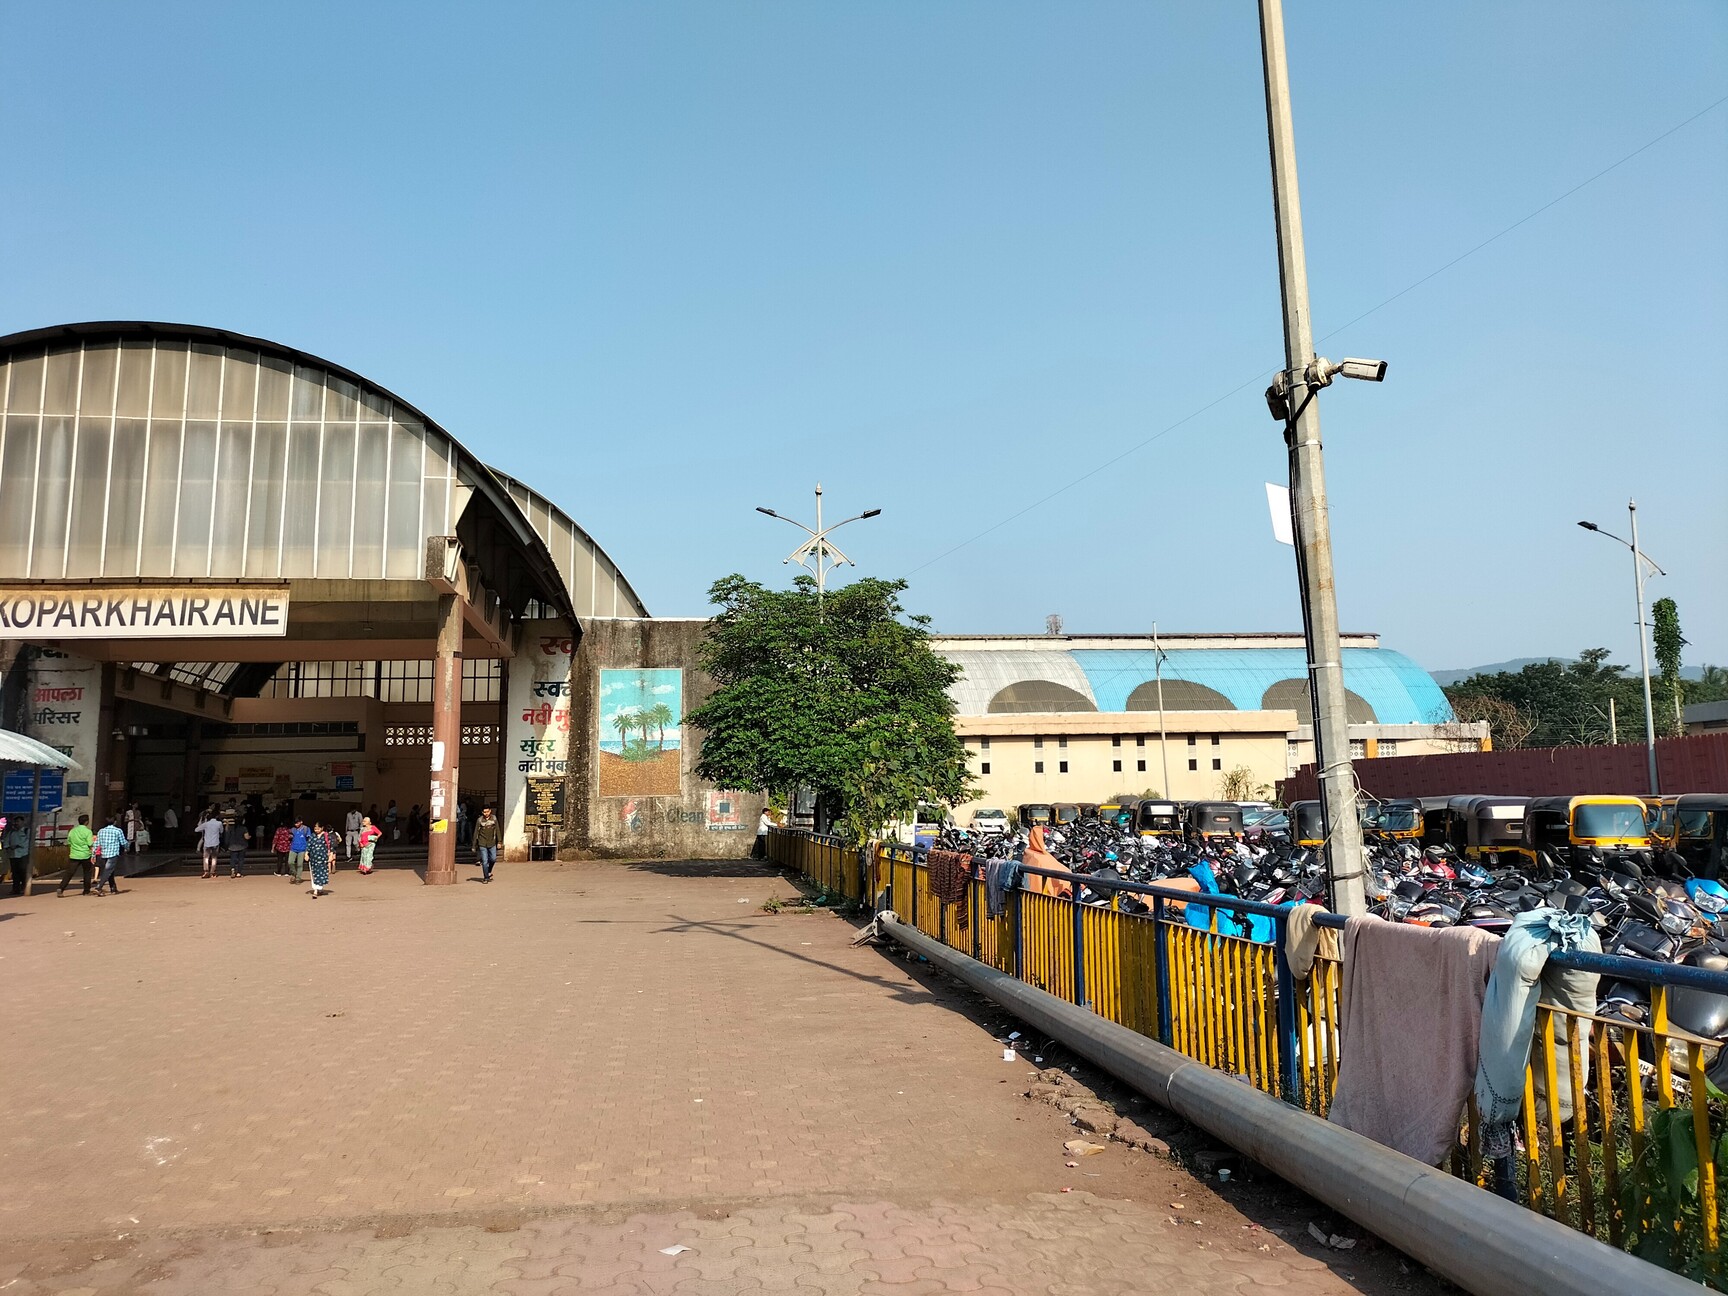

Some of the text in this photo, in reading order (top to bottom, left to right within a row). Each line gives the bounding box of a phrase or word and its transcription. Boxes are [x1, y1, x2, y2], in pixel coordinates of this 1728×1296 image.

[0, 594, 280, 628] KOPARKHAIRANE
[33, 708, 81, 724] परिसर
[522, 703, 553, 725] नवी
[520, 737, 556, 757] सुंदर
[518, 757, 544, 772] नवी
[667, 804, 704, 823] Clean
